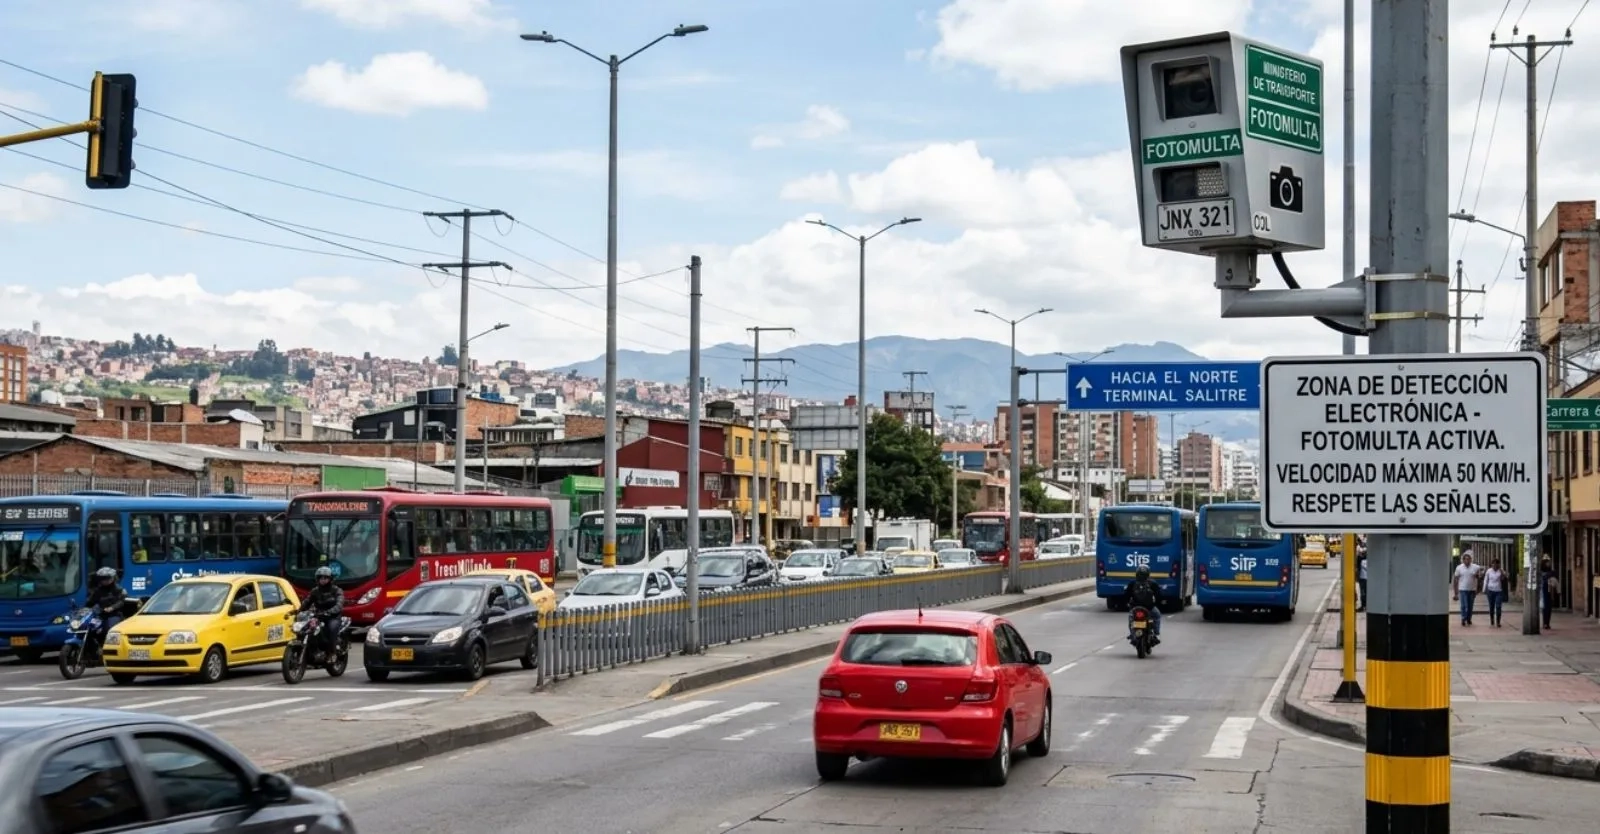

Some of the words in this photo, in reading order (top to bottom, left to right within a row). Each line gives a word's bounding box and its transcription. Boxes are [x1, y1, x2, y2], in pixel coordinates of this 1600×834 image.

[1253, 76, 1264, 92] DE
[1251, 107, 1319, 142] FOTOMULTA
[1146, 134, 1241, 159] FOTOMULTA
[1160, 208, 1193, 231] JNX
[1199, 205, 1230, 228] 321
[1111, 371, 1157, 384] HACIA
[1164, 371, 1181, 383] EL
[1190, 370, 1238, 383] NORTE
[1297, 376, 1353, 396] ZONA
[1358, 376, 1385, 395] DE
[1391, 369, 1508, 396] DETECCIÓN
[1103, 389, 1177, 402] TERMINAL
[1185, 388, 1247, 402] SALITRE
[1326, 399, 1468, 423] ELECTRÓNICA
[1302, 431, 1421, 451] FOTOMULTA
[1426, 430, 1505, 451] ACTIVA.
[1276, 463, 1376, 483] VELOCIDAD
[1383, 459, 1452, 483] MÁXIMA
[1457, 463, 1476, 483] 50
[1482, 462, 1531, 483] KM/H.
[1293, 493, 1376, 513] RESPETE
[1382, 493, 1418, 513] LAS
[1424, 489, 1515, 513] SEÑALES.
